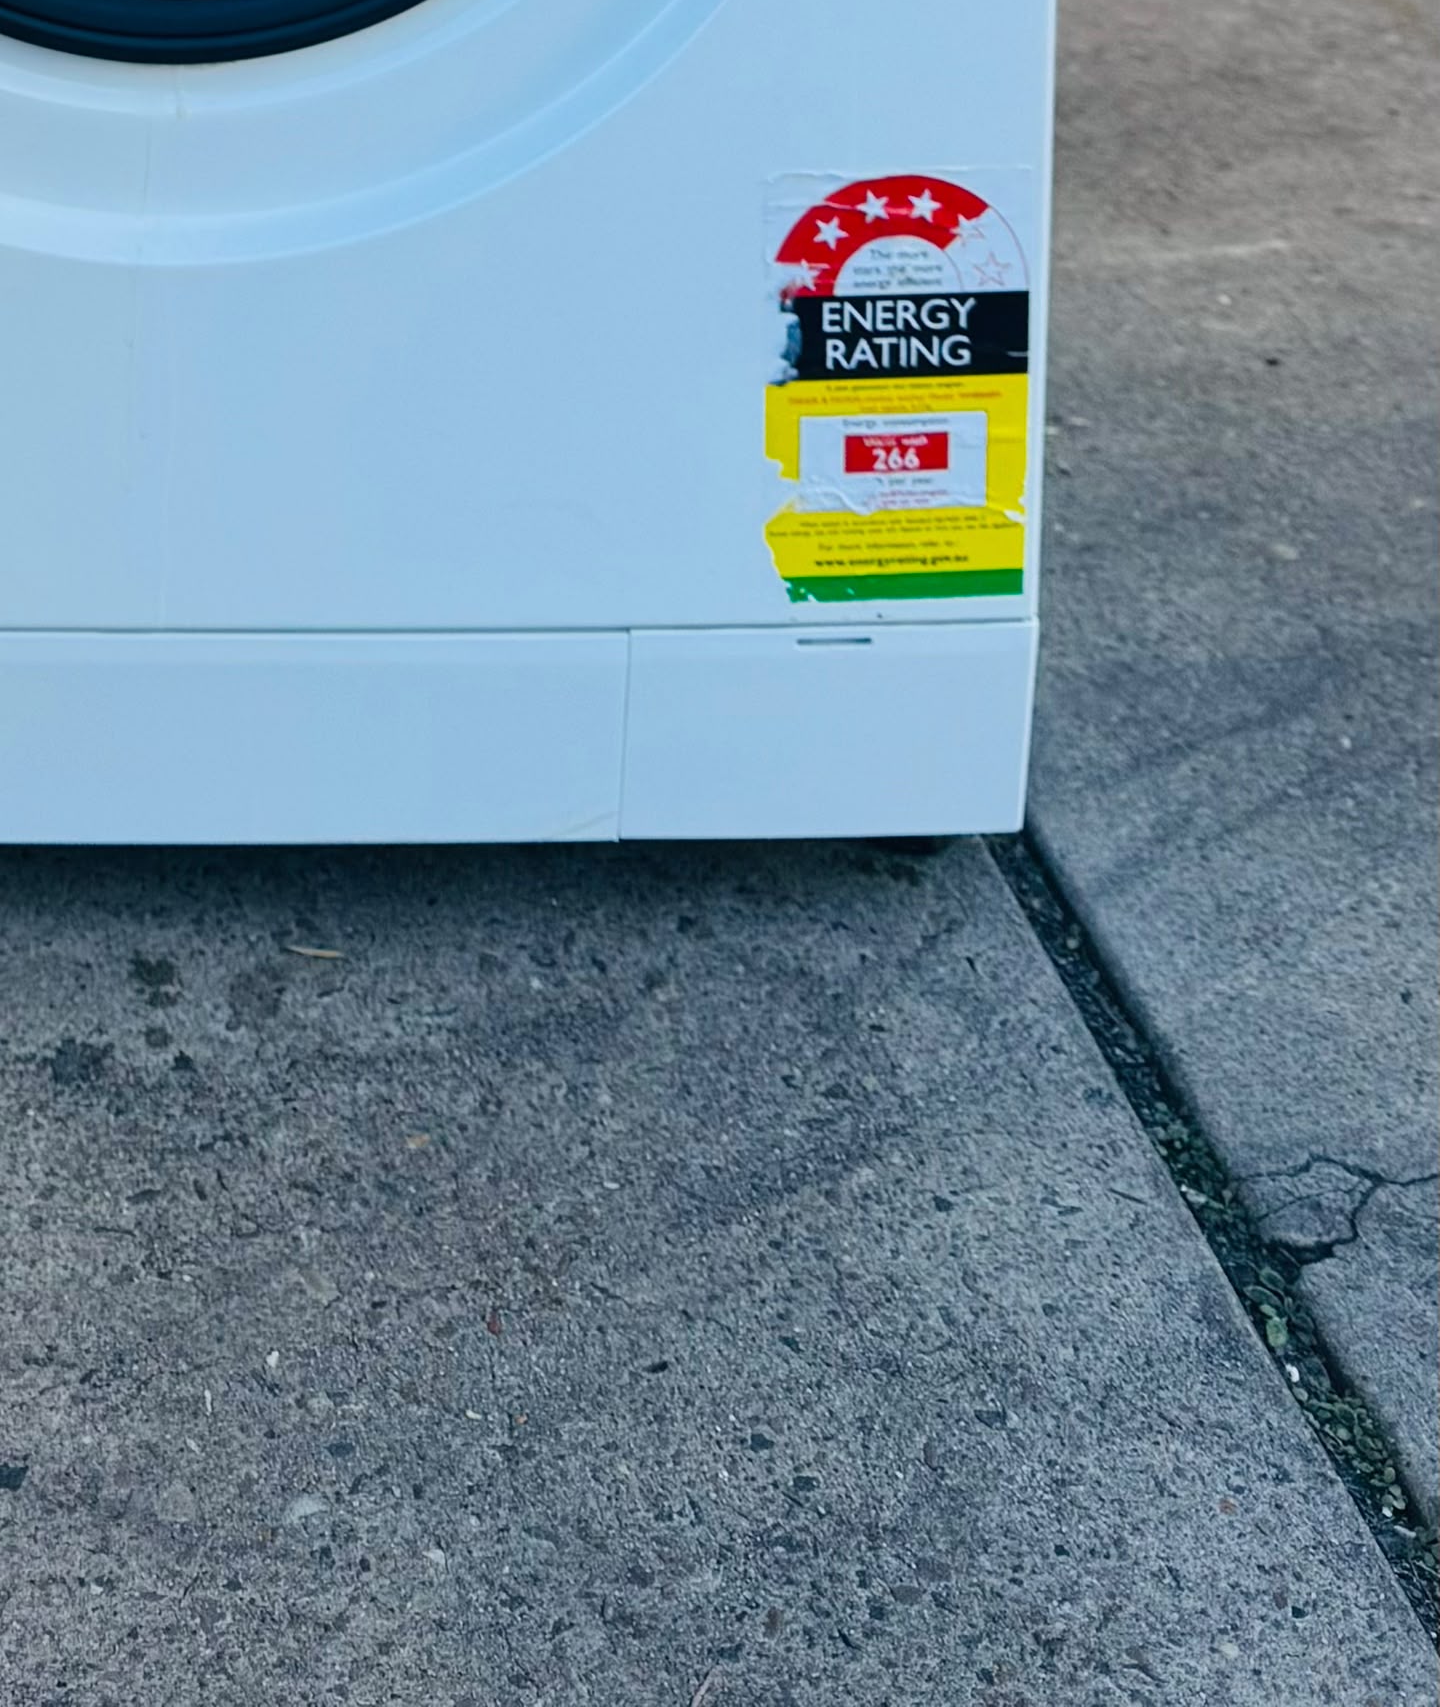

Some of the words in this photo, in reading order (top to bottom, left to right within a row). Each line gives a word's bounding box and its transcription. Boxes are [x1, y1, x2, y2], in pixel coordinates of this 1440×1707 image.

[822, 296, 975, 332] ENERGY
[826, 335, 971, 369] RATING
[873, 448, 921, 472] 266
